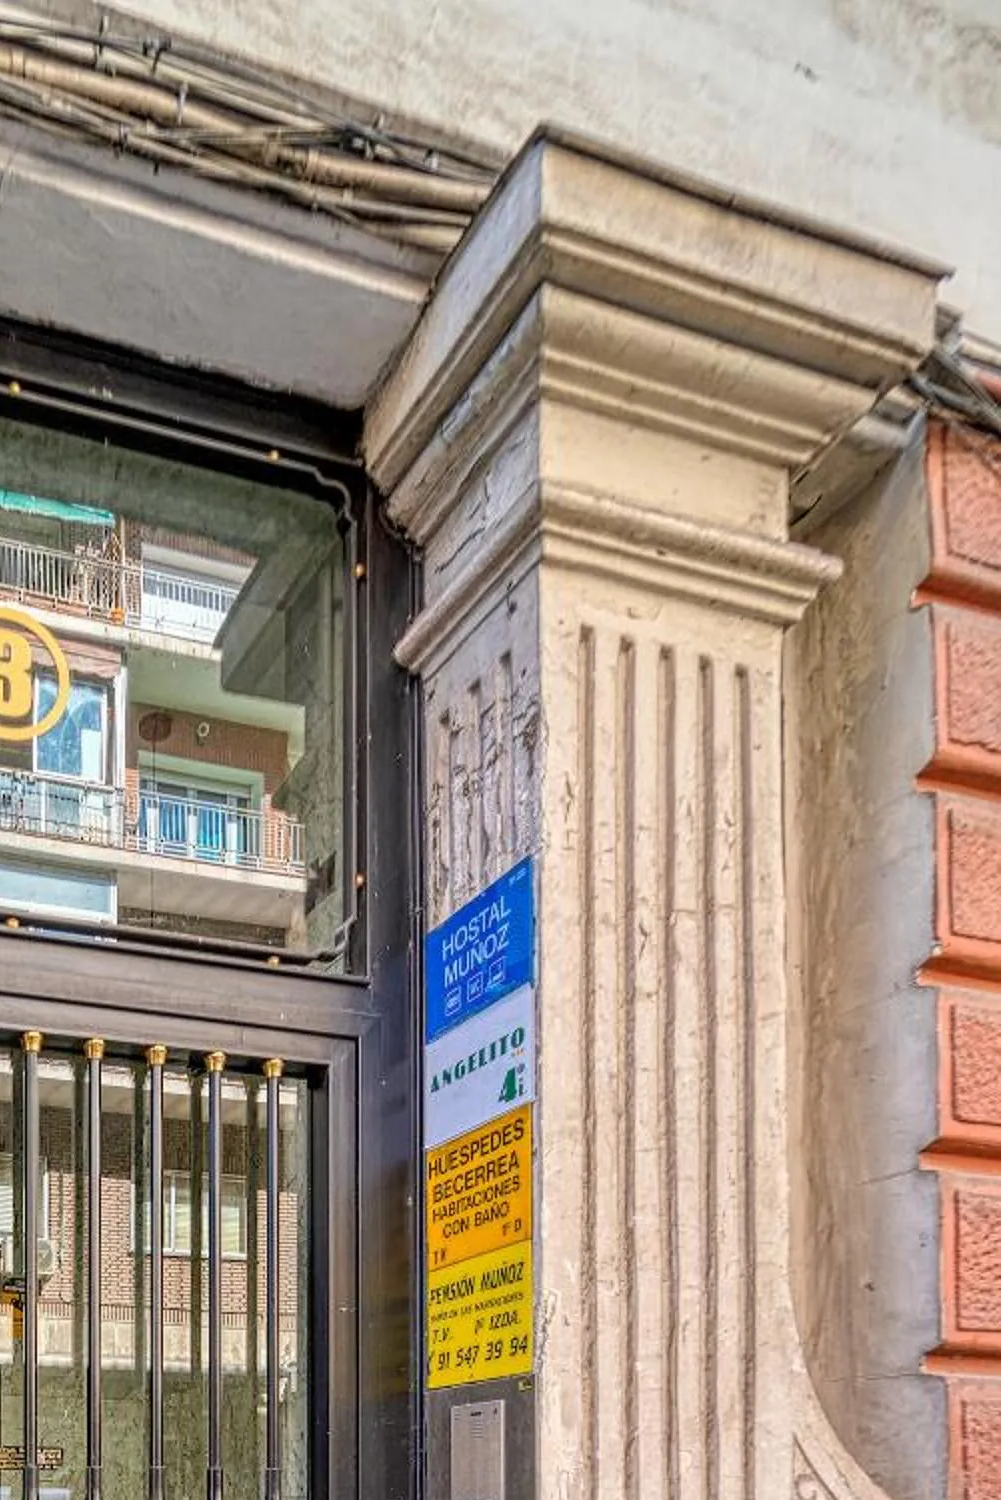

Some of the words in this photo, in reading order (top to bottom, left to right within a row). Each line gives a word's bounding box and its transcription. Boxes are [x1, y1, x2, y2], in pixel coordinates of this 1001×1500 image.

[442, 895, 512, 962] HOSTAL
[444, 921, 510, 989] MUÑOZ
[431, 1027, 525, 1093] ANGELITO
[428, 1117, 524, 1181] HUESPEDES
[433, 1149, 520, 1204] BECERREA
[432, 1175, 520, 1225] HABITACIONES
[442, 1214, 470, 1240] CON
[474, 1199, 510, 1228] BAÑO
[429, 1274, 476, 1306] PENSIÓN
[480, 1260, 525, 1294] MUÑOZ
[454, 1345, 480, 1369] 547
[484, 1339, 504, 1362] 39
[508, 1333, 529, 1358] 94
